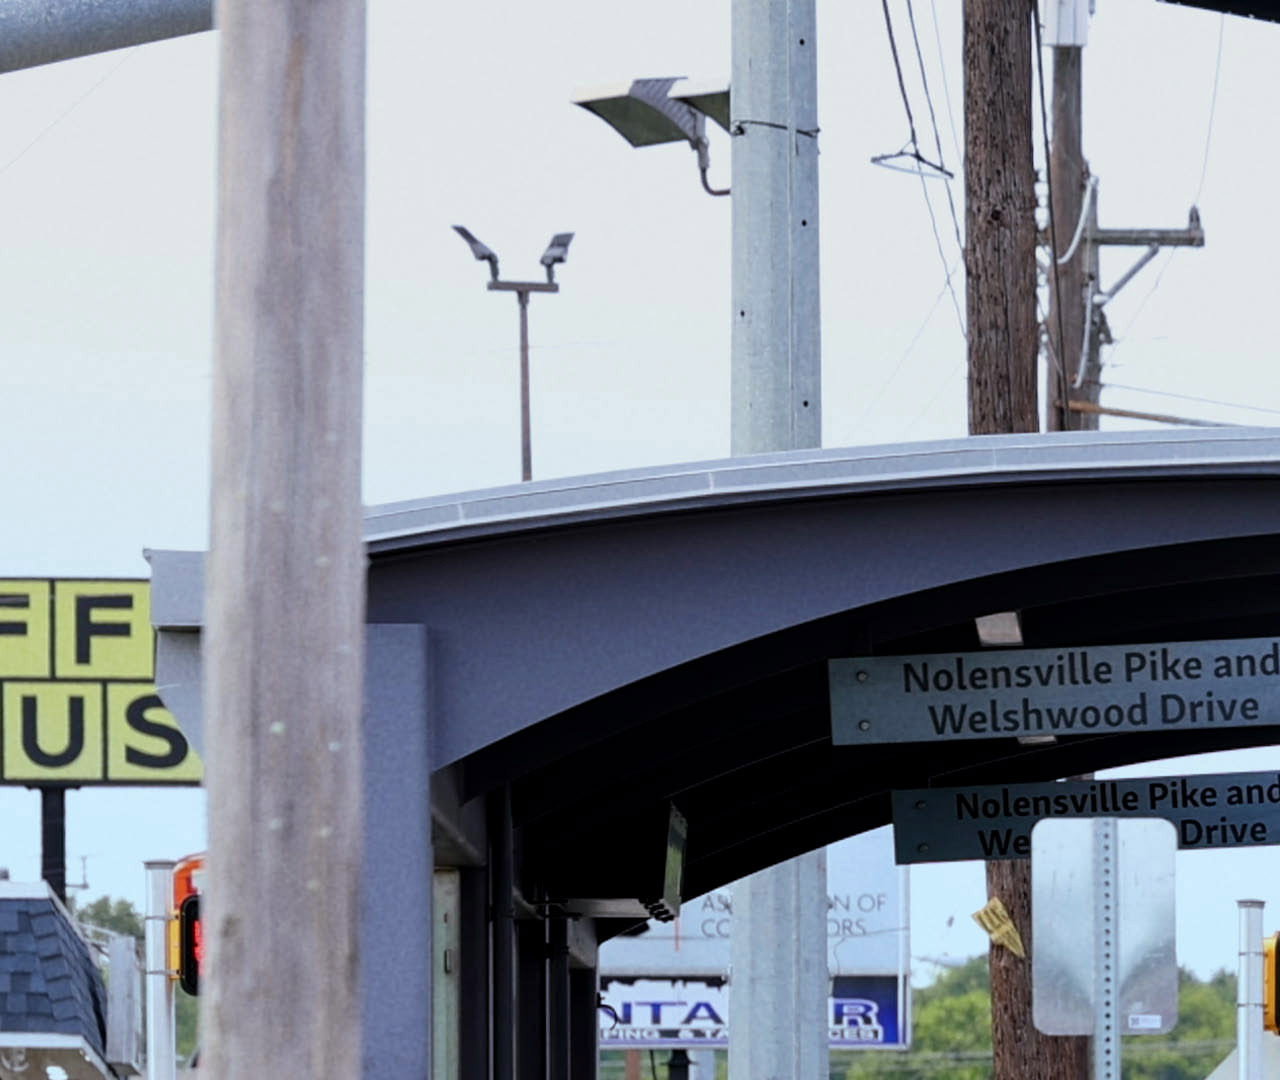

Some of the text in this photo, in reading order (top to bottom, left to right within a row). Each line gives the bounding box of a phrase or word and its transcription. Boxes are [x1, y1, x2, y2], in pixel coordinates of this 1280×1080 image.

[903, 643, 1280, 693] Nolensville Pike and
[21, 694, 189, 768] US
[928, 691, 1259, 736] Welshwood Drive
[955, 781, 1137, 820] Nolensville
[1148, 779, 1217, 811] Pike
[1181, 818, 1267, 846] Drive
